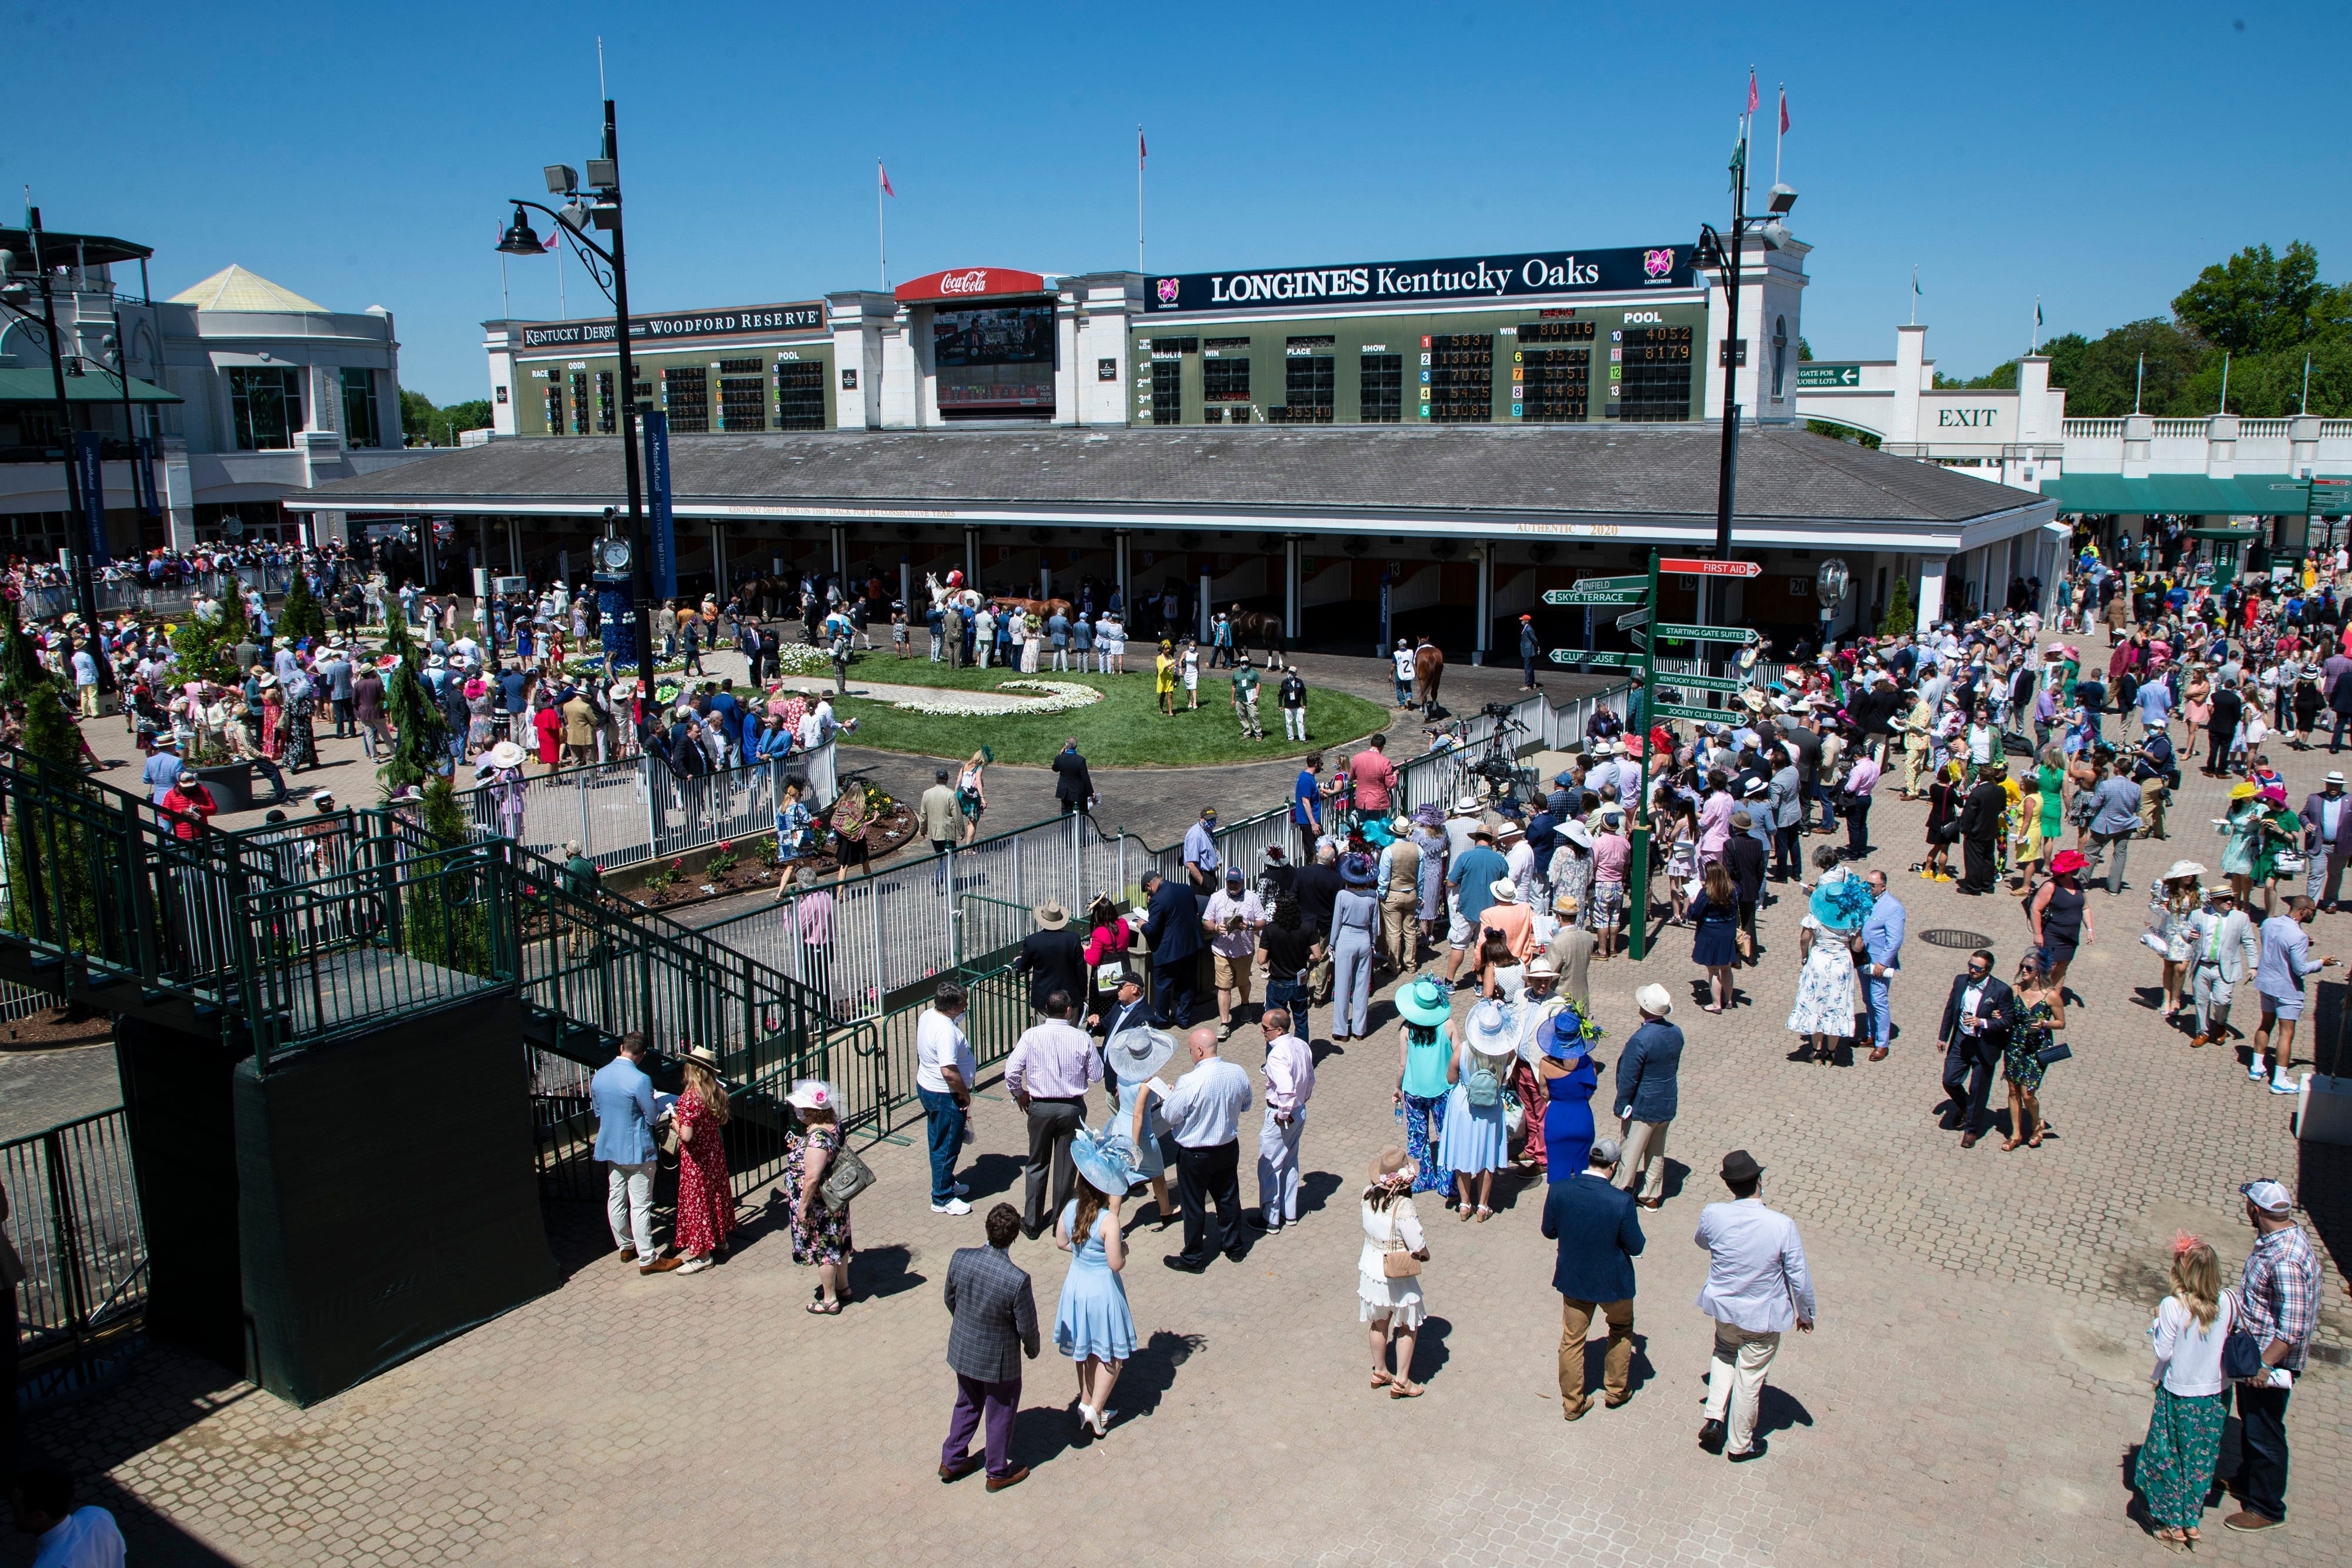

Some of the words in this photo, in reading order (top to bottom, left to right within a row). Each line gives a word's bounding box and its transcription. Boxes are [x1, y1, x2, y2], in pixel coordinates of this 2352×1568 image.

[941, 270, 987, 294] Coca-Cola
[1211, 268, 1369, 302] LONGINES
[1377, 261, 1513, 296] Kentucky
[1522, 256, 1598, 287] Oaks
[1543, 309, 1573, 317] SHOW
[1624, 312, 1662, 324] POOL
[650, 316, 735, 334] WOODFORD
[1541, 322, 1592, 335] 80116
[525, 328, 579, 346] KENTUCKY
[583, 325, 616, 340] DERBY
[1612, 330, 1621, 342] 10
[1646, 328, 1689, 340] 4052
[1424, 337, 1429, 347] 1
[778, 351, 799, 360] POOL
[1442, 352, 1490, 364] 13376
[1515, 352, 1522, 362] 6
[1546, 350, 1587, 361] 3525
[1612, 350, 1620, 360] 11
[1646, 346, 1689, 359] 8179
[1423, 355, 1428, 363] 2
[569, 362, 586, 370] ODDS
[1139, 361, 1151, 372] 1st
[532, 370, 549, 378] RACE
[1422, 372, 1428, 381] 3
[1515, 370, 1522, 379] 7
[1545, 368, 1585, 379] 5651
[1612, 367, 1621, 377] 12
[1137, 377, 1151, 388] 2nd
[1422, 389, 1428, 397] 4
[1515, 388, 1521, 397] 8
[1545, 386, 1586, 397] 4488
[1611, 386, 1619, 396] 13
[1138, 394, 1151, 404] 3rd
[1138, 409, 1151, 419] 4th
[1252, 404, 1264, 422] PAYS
[1422, 406, 1428, 415] 5
[1442, 405, 1489, 416] 19084
[1514, 406, 1521, 414] 9
[1545, 403, 1584, 415] 3411
[1938, 409, 1997, 427] EXIT
[653, 442, 662, 492] MassMutual
[868, 509, 880, 517] 147
[655, 503, 664, 542] KENTUCKY
[1516, 523, 1576, 533] AUTHENTIC
[1590, 524, 1618, 536] 2020
[1001, 549, 1007, 559] 8
[1144, 551, 1153, 565] 10
[2220, 544, 2229, 566] RAMS
[1304, 559, 1312, 571] 12
[1389, 561, 1400, 576] 13
[1703, 563, 1728, 573] FIRST
[1730, 565, 1746, 574] AID
[1583, 581, 1610, 590] INFIELD
[1681, 575, 1696, 589] 19
[1790, 580, 1807, 594] 20
[1582, 593, 1623, 601] TERRACE
[1084, 602, 1093, 613] 10
[1666, 627, 1699, 636] STARTING
[1562, 652, 1614, 663] CLUBHOUSE
[1402, 660, 1411, 674] 2
[1659, 676, 1690, 684] KENTUCKY
[1668, 708, 1693, 717] JOCKEY
[1713, 713, 1735, 721] SUITES
